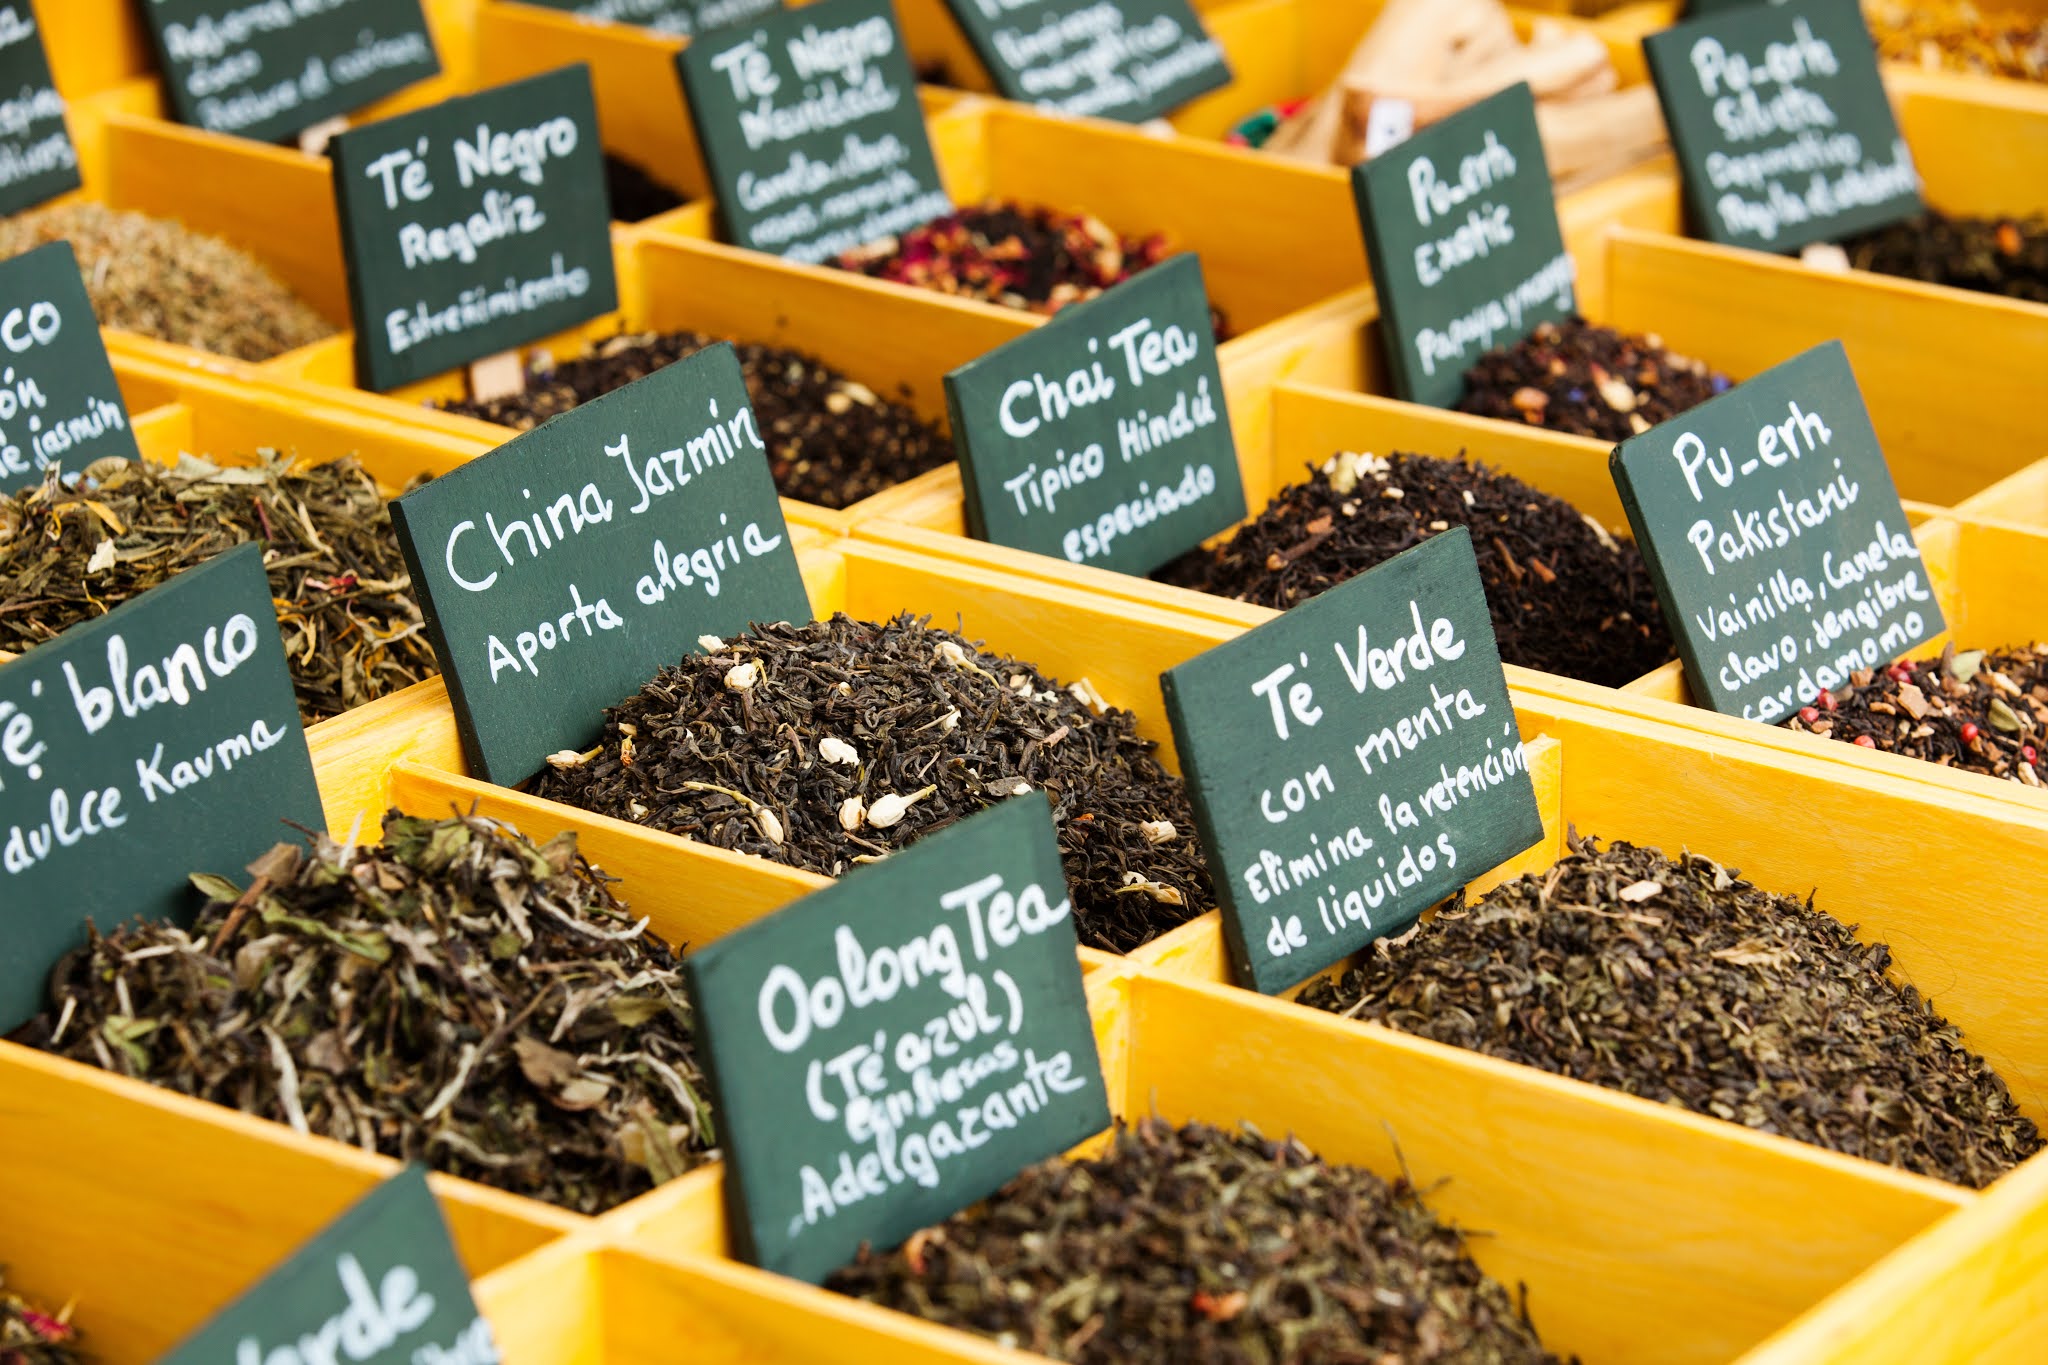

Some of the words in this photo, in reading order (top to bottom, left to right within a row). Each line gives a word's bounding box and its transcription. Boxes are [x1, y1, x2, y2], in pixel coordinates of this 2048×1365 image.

[710, 29, 781, 102] Té
[786, 15, 893, 86] Negro
[366, 136, 434, 210] Té
[453, 116, 578, 188] Negro
[399, 189, 547, 269] Regaliz
[999, 337, 1116, 439] Chai
[1108, 317, 1199, 388] Tea
[1117, 374, 1218, 464] Hindú
[445, 488, 613, 592] China
[1062, 463, 1217, 565] especiado
[1687, 457, 1860, 575] Pakistani
[1822, 520, 1921, 590] Canela
[62, 613, 259, 735] blanco
[488, 584, 624, 684] Aporta
[1250, 651, 1323, 741] Té
[1334, 600, 1466, 694] Verde
[1742, 611, 1924, 724] cardamomo
[1261, 764, 1335, 824] con
[1354, 683, 1487, 775] menta
[3, 787, 128, 875] dulce
[1243, 825, 1373, 904] Elimina
[1379, 793, 1419, 880] la
[1418, 722, 1531, 817] retención
[758, 924, 967, 1053] Oolong
[940, 873, 1072, 961] Tea
[1266, 915, 1308, 957] de
[806, 1029, 888, 1122] (Té
[895, 969, 1024, 1073] azul)
[799, 1048, 1087, 1226] Adelgazante
